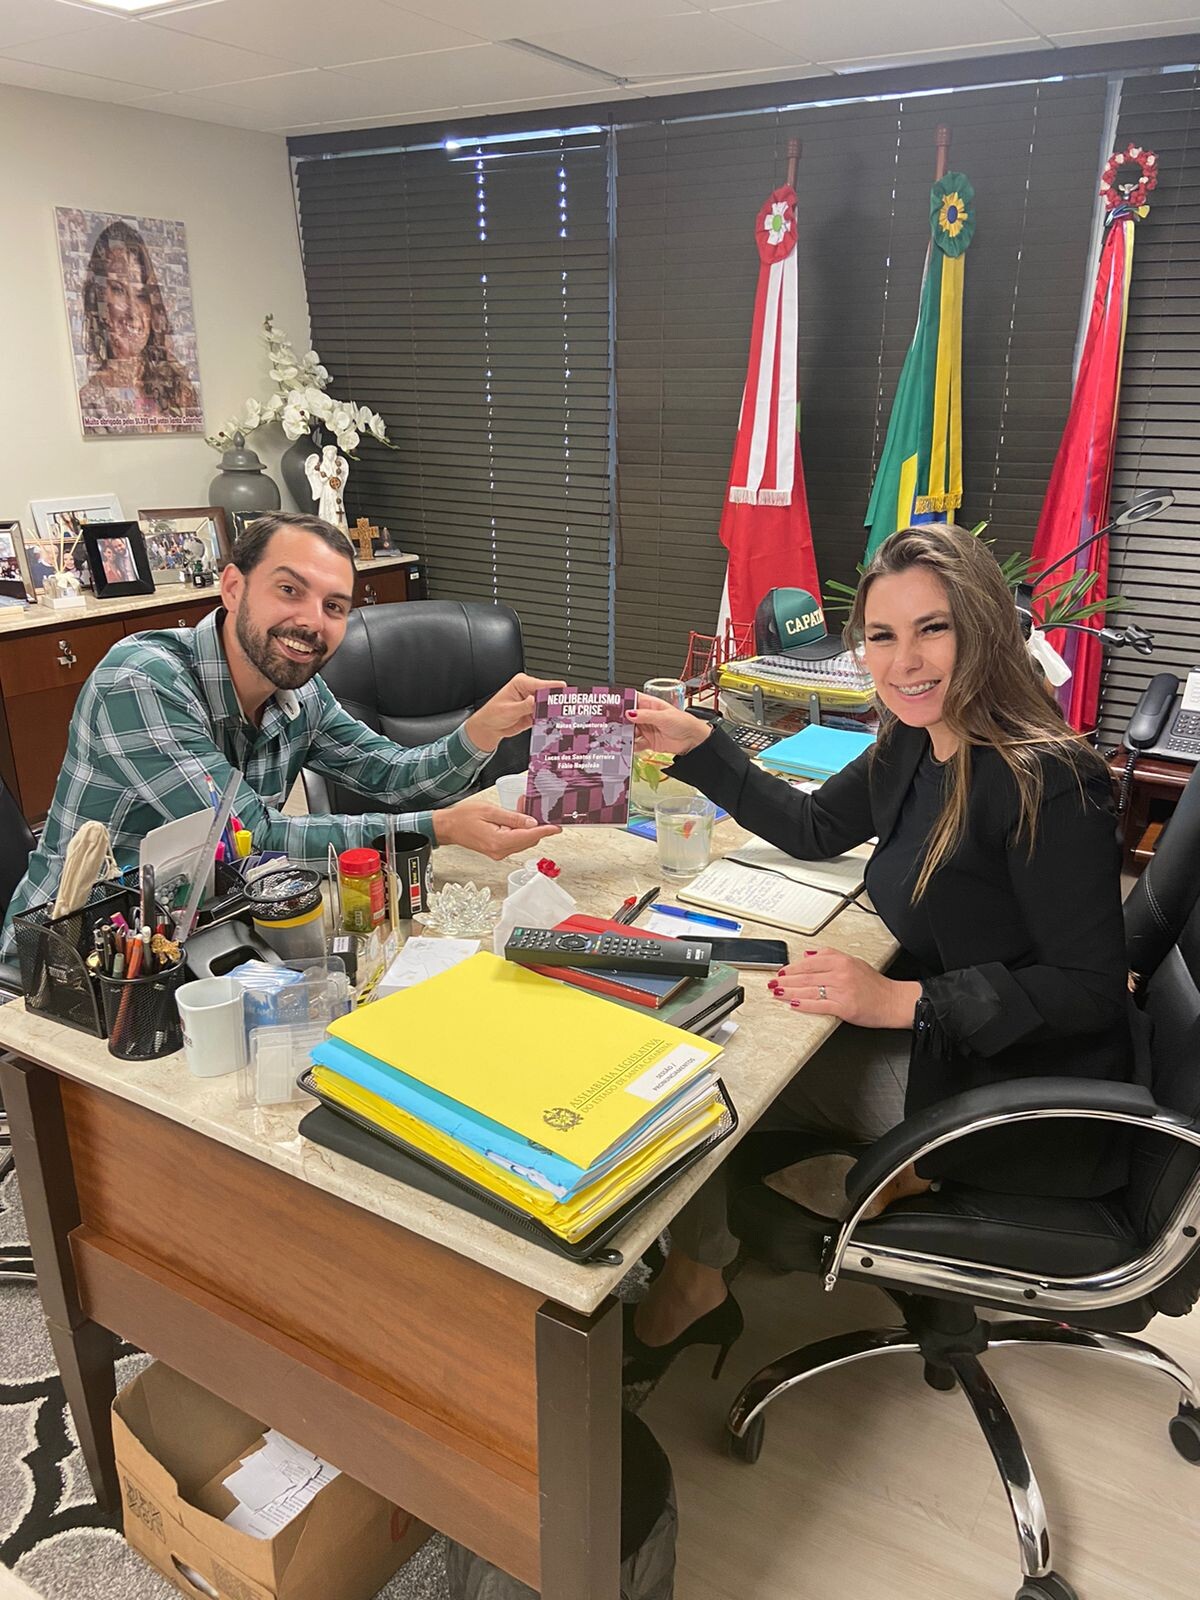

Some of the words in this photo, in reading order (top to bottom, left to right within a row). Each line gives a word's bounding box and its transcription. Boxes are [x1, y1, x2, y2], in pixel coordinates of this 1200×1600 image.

[547, 693, 621, 705] NEOLIBERALISMO
[562, 705, 576, 715] EM
[577, 705, 603, 715] CRISE
[569, 1067, 617, 1108] ASSEMBLEIA
[614, 1038, 661, 1074] LEGISLATIVA
[581, 1103, 594, 1113] DO
[593, 1082, 617, 1106] ESTADO
[615, 1077, 626, 1087] DE
[625, 1063, 645, 1080] SANTA
[642, 1042, 673, 1065] CATARINA
